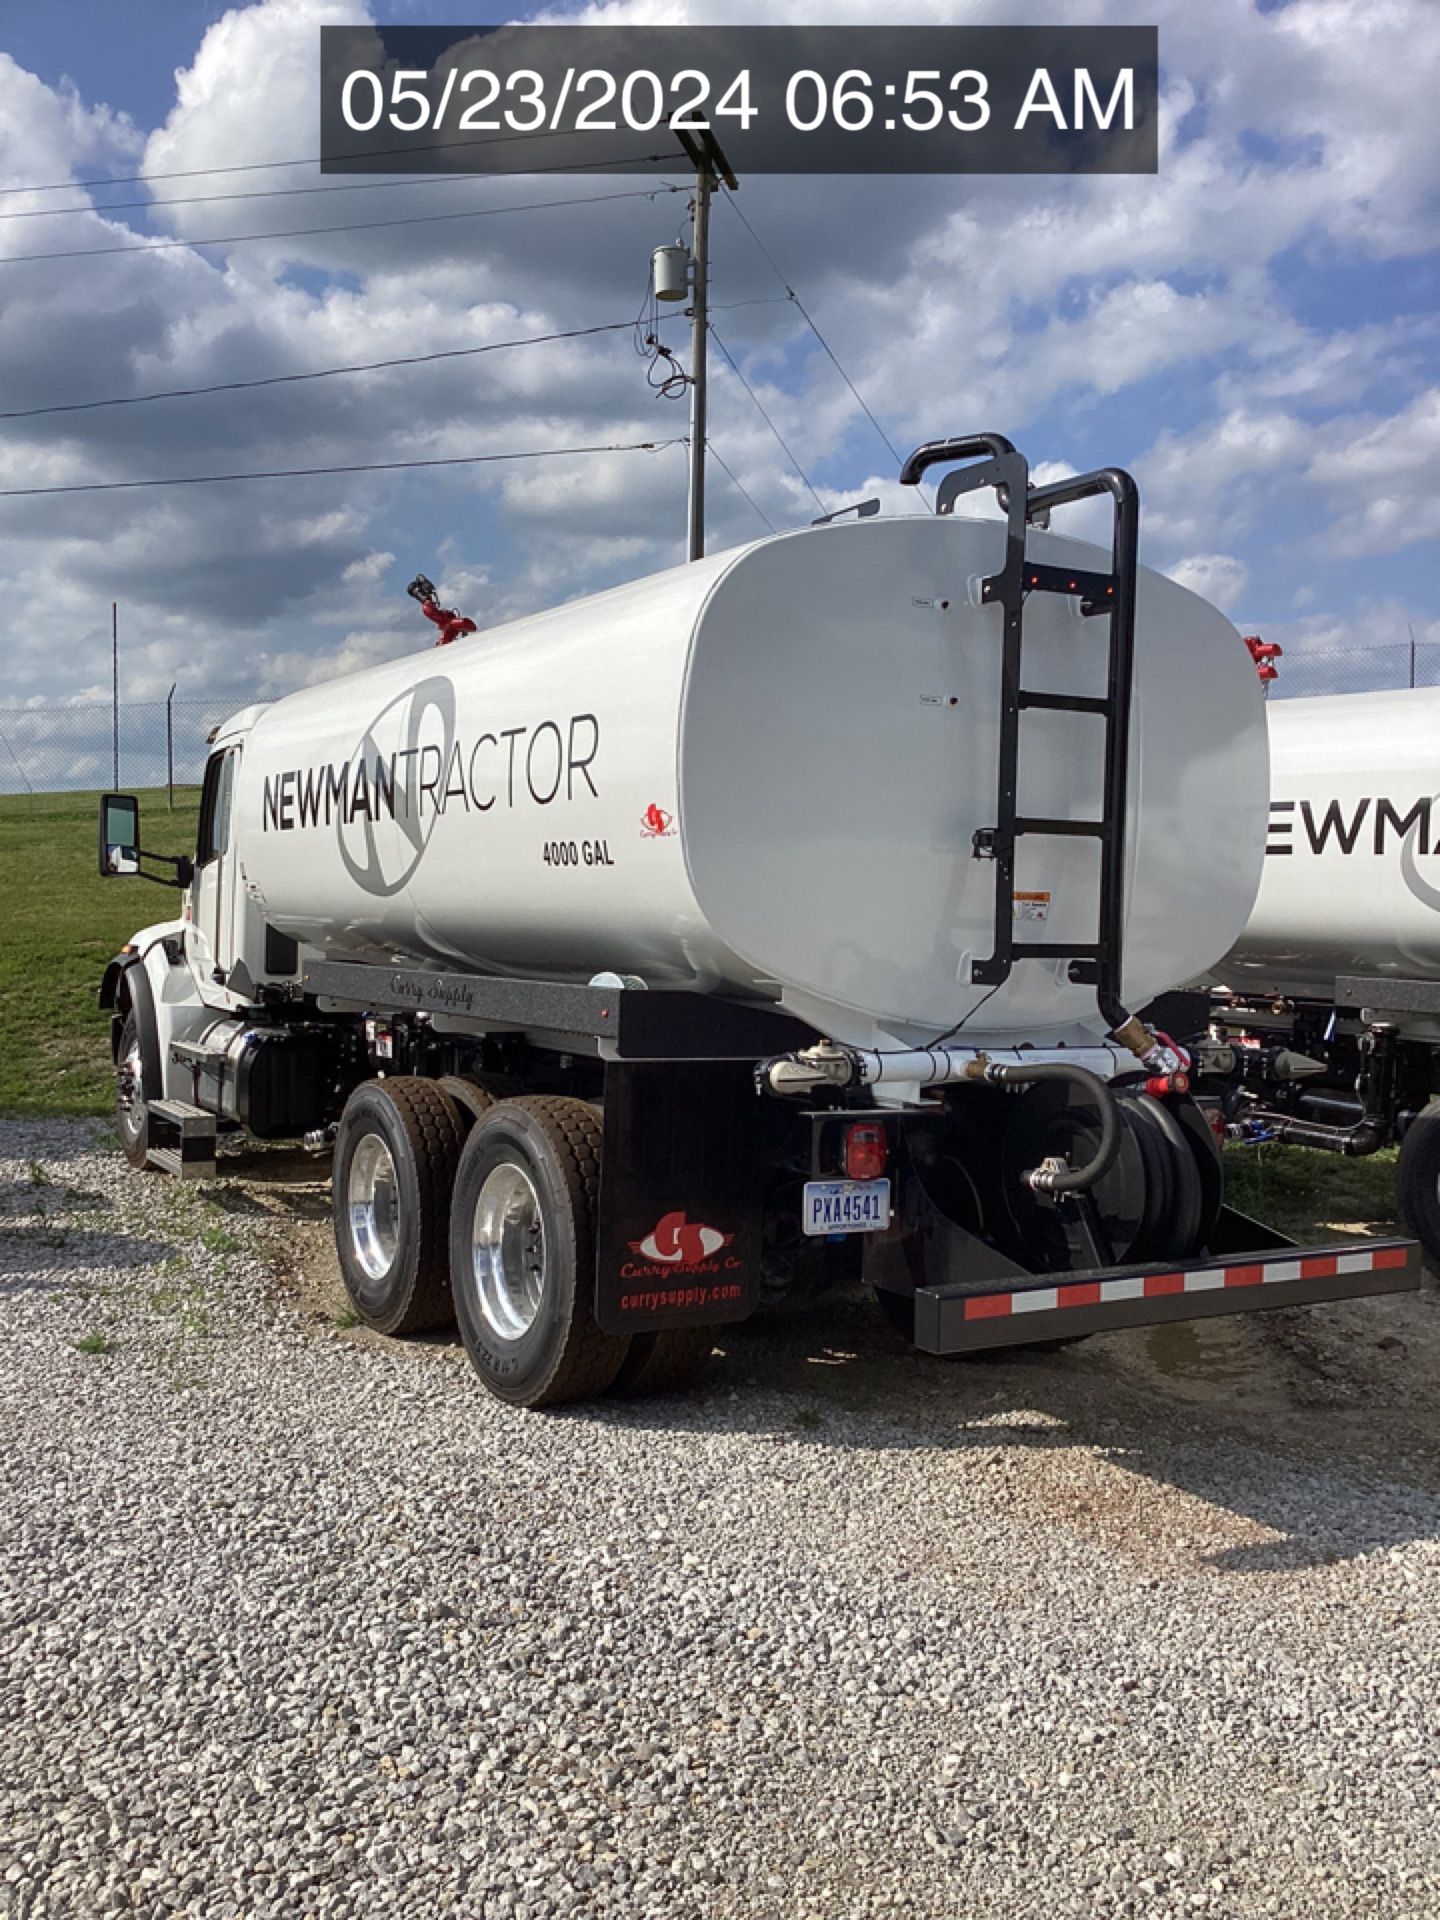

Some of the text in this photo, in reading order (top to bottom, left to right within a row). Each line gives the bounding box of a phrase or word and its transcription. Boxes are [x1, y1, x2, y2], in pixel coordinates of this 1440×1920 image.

[543, 840, 615, 867] 4000 GAL
[813, 1195, 881, 1225] PXA4541
[620, 1262, 671, 1279] Curry
[620, 1284, 742, 1311] currysupply.com
